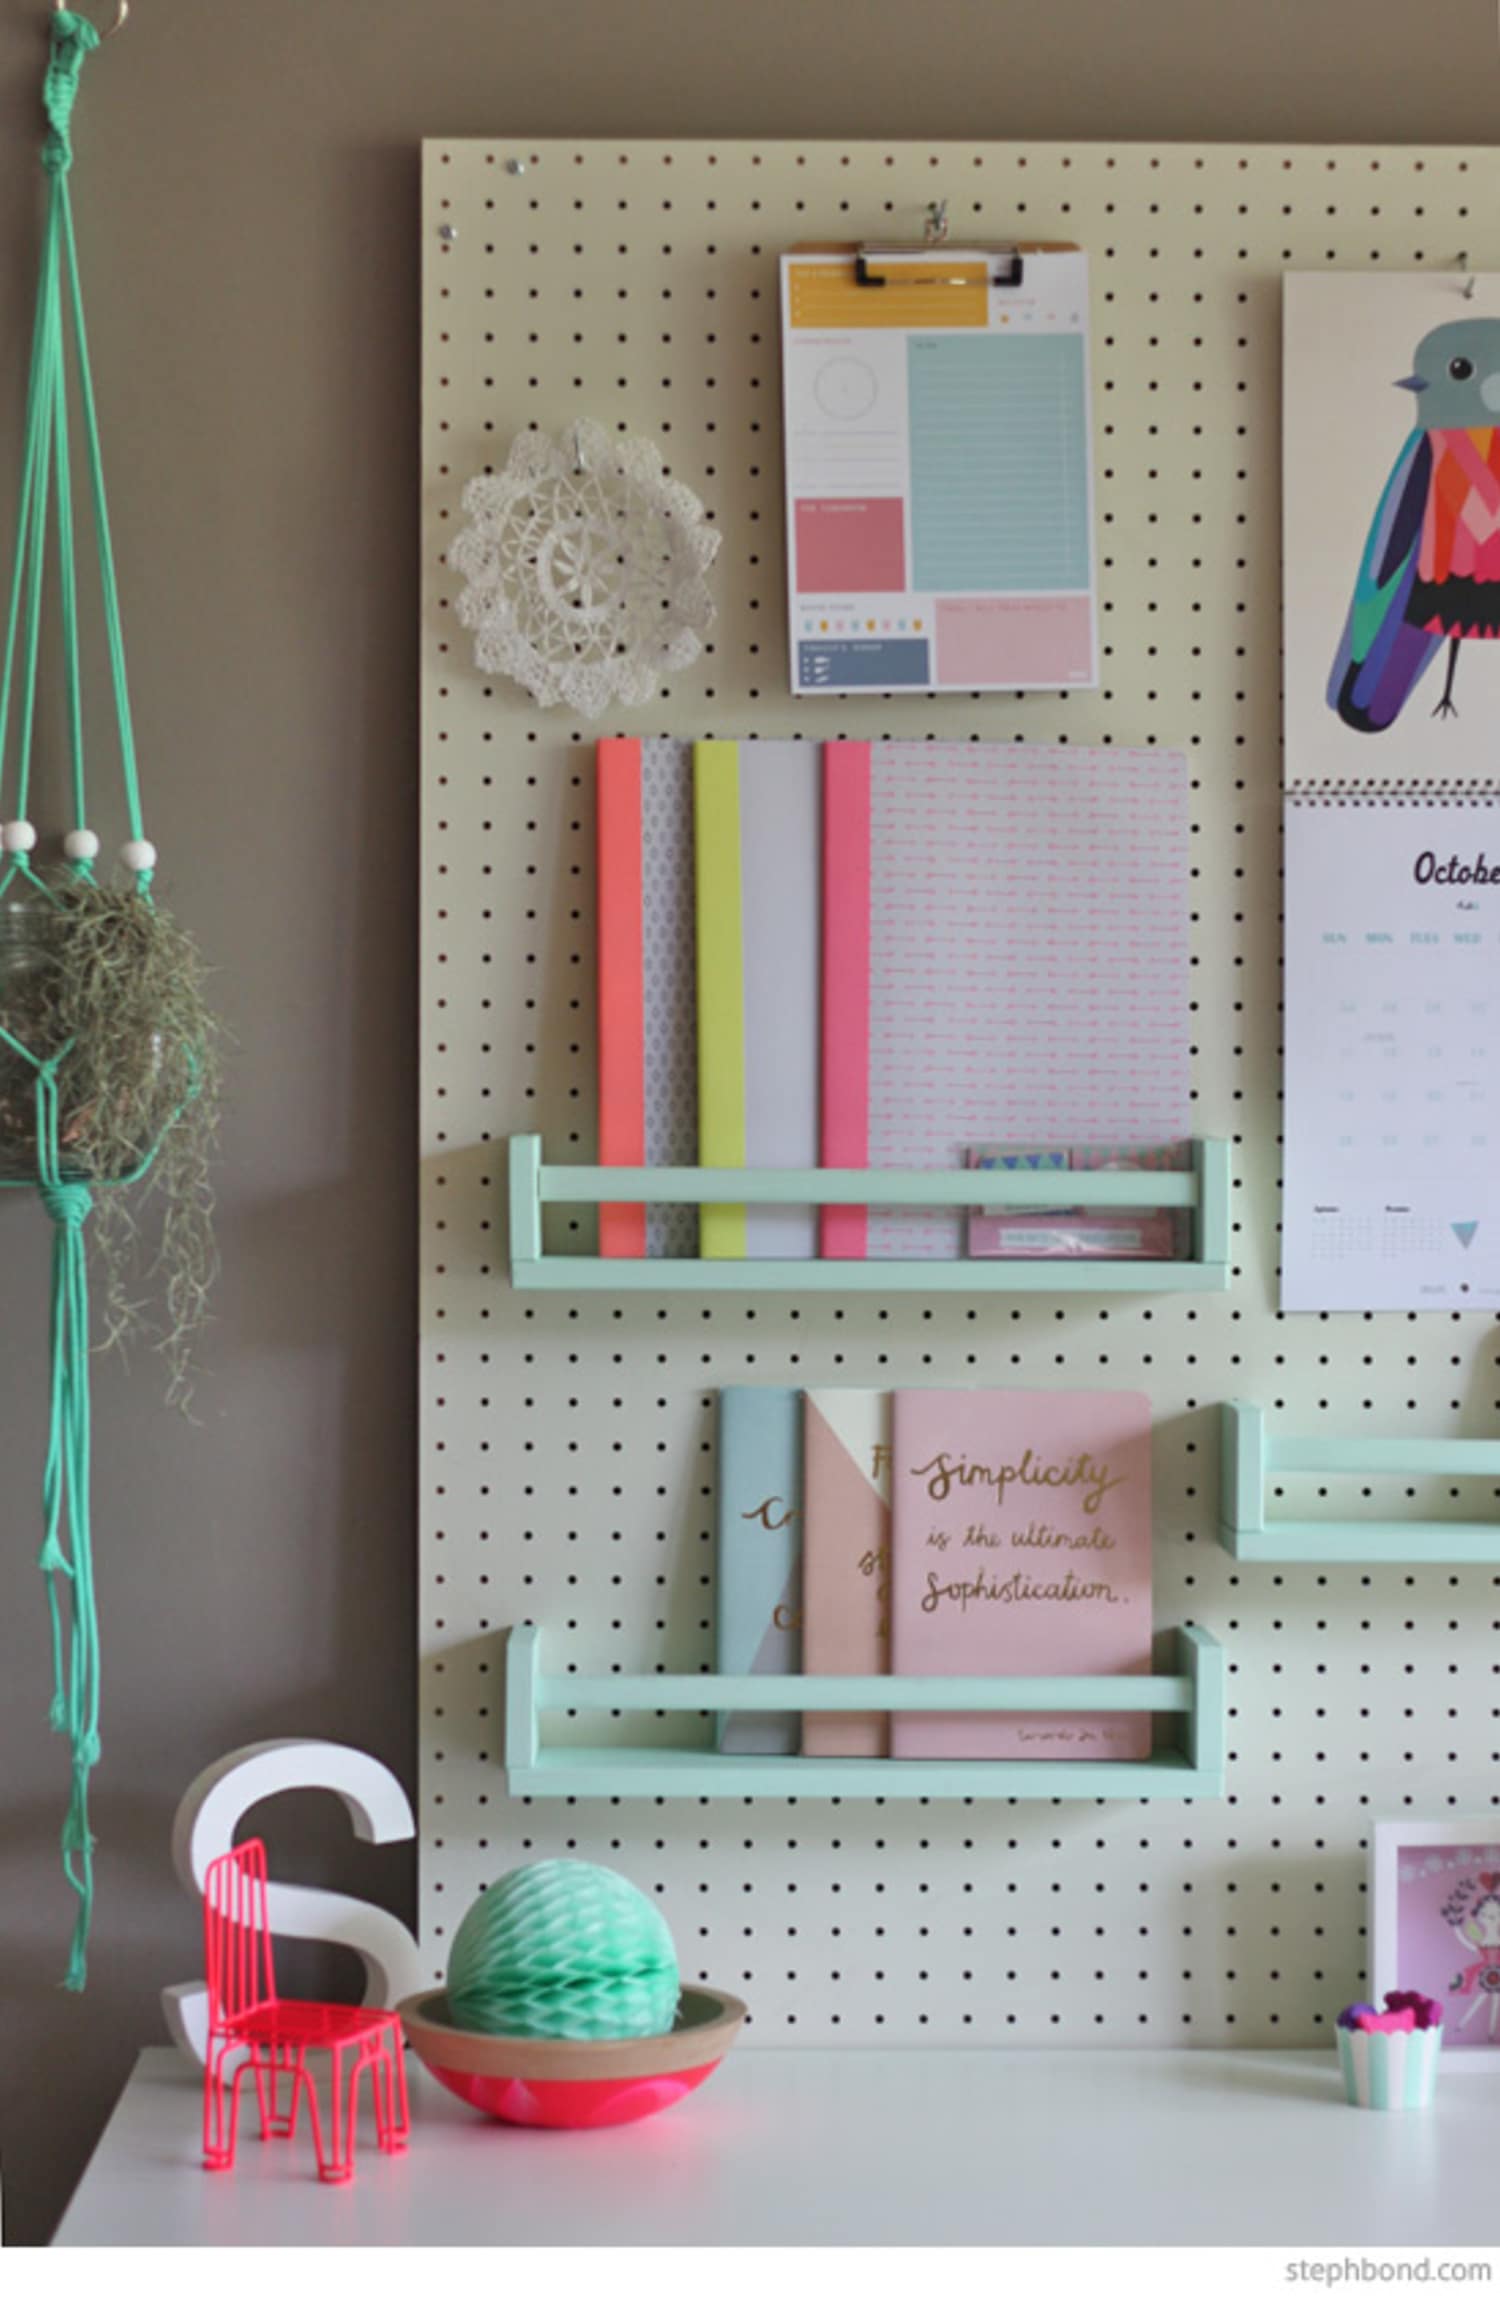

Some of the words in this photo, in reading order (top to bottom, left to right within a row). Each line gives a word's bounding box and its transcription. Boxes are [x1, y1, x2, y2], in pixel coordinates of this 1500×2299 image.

[910, 1448, 1129, 1515] Simplicity
[926, 1526, 951, 1551] is
[962, 1522, 1000, 1548] the
[1011, 1520, 1116, 1550] ultimate
